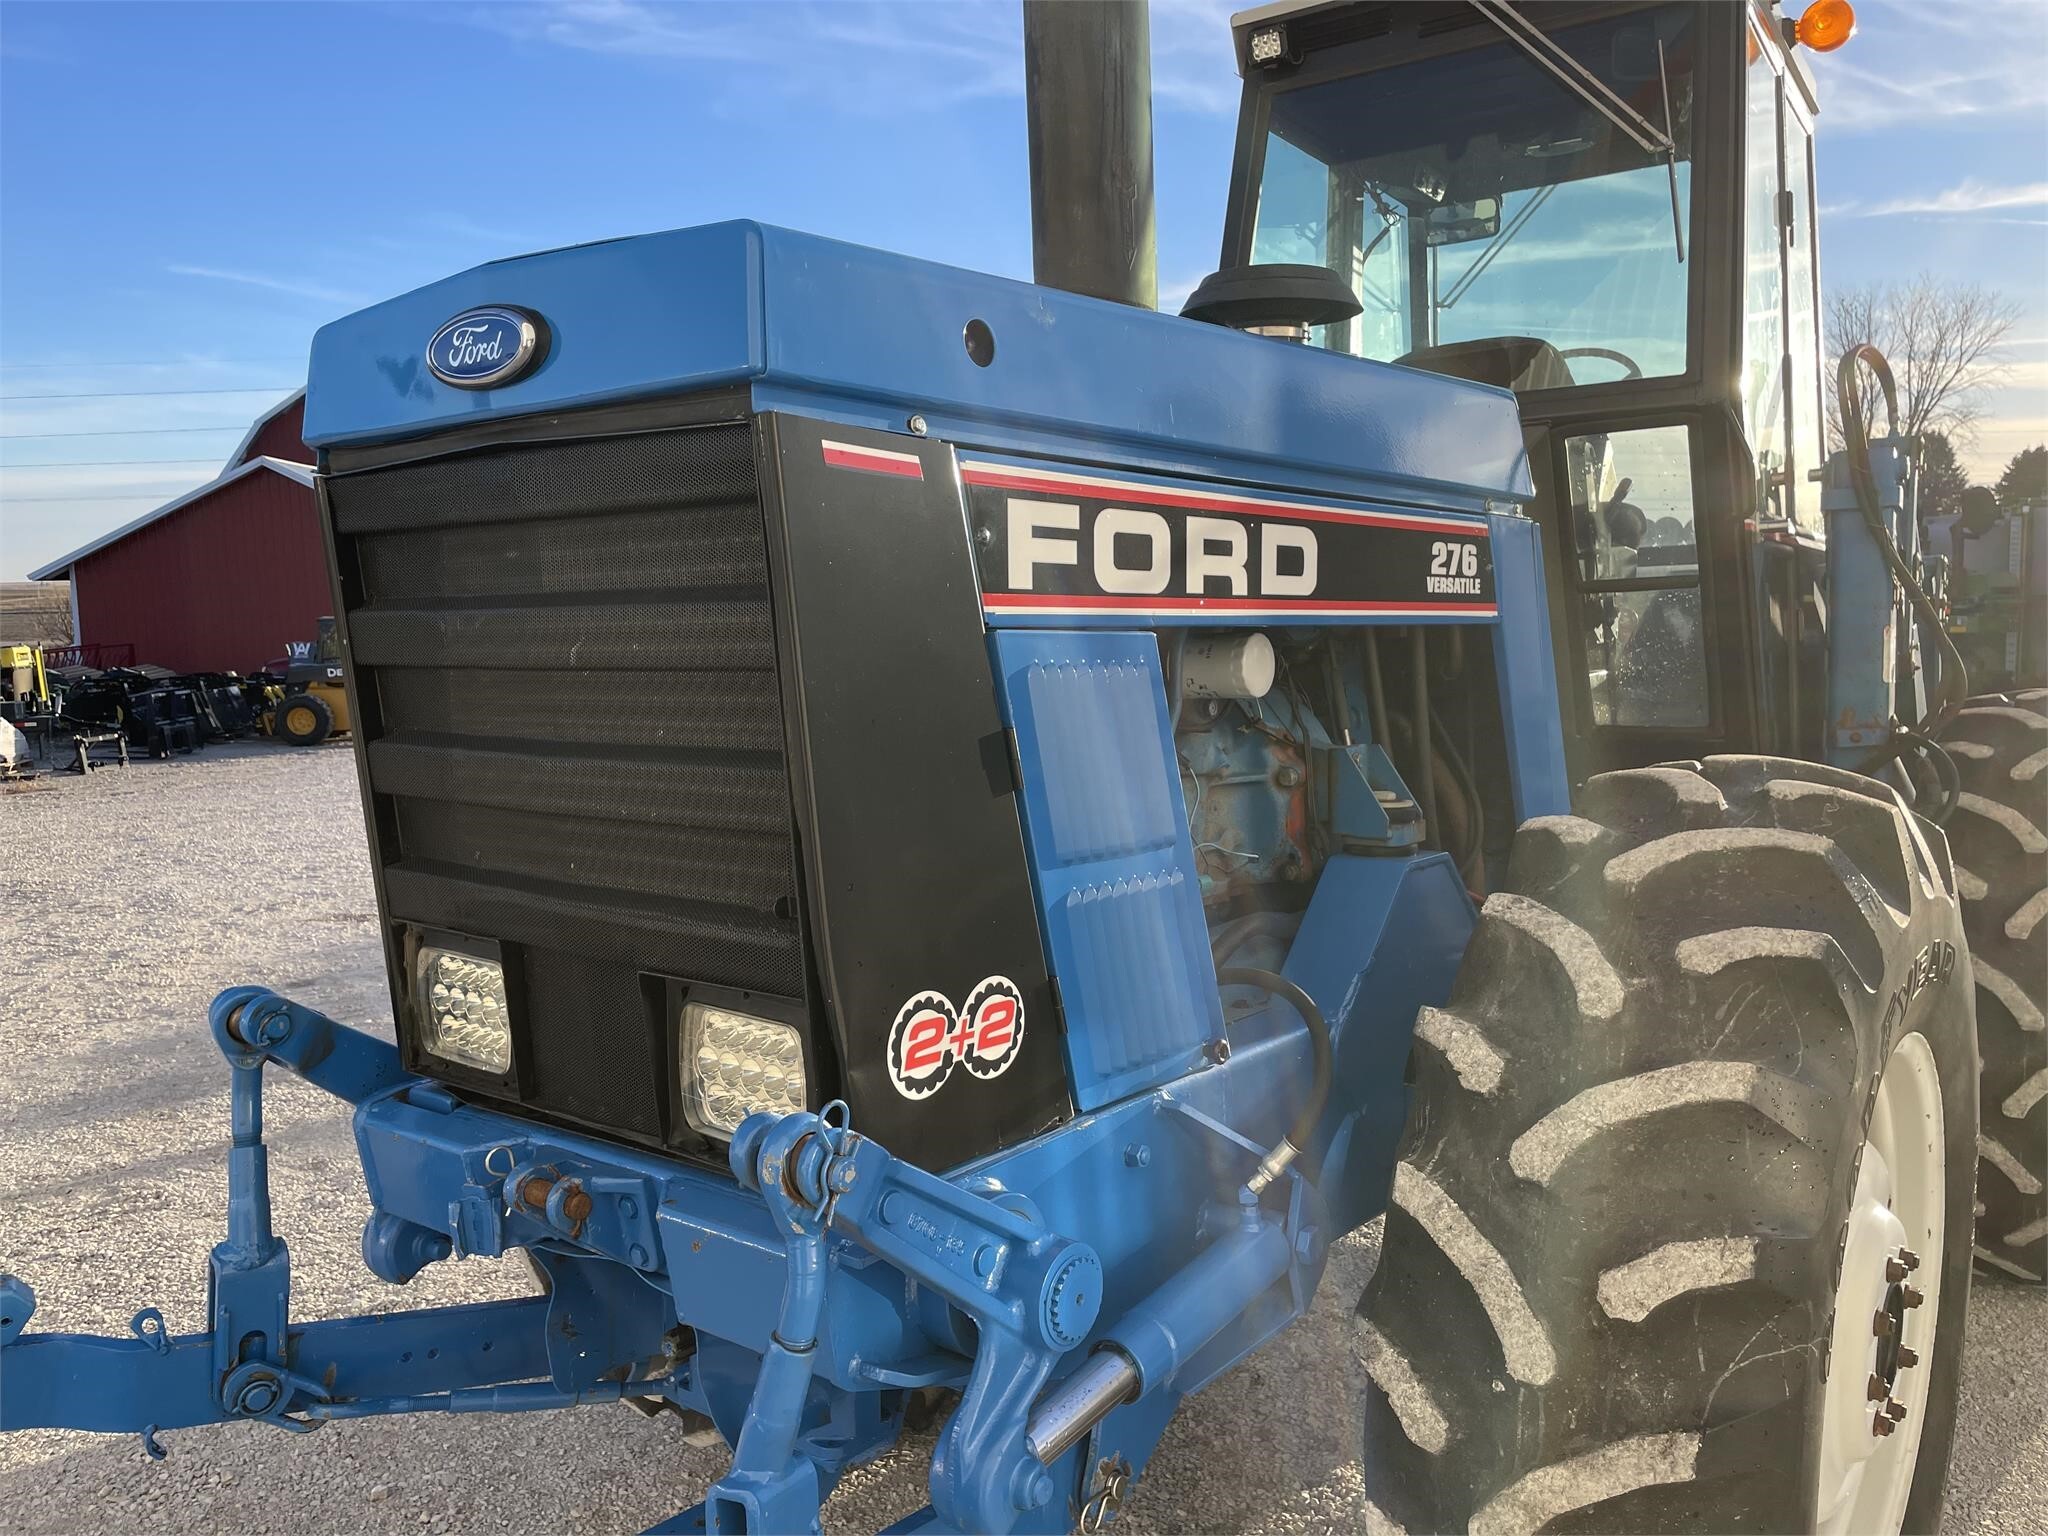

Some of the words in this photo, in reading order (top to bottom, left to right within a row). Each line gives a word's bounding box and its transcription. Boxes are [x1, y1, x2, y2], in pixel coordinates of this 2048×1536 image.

[449, 324, 502, 367] Ford
[1007, 498, 1318, 596] FORD
[1431, 541, 1478, 577] 276
[1426, 576, 1481, 595] VERSATILE
[904, 999, 1016, 1072] 2+2
